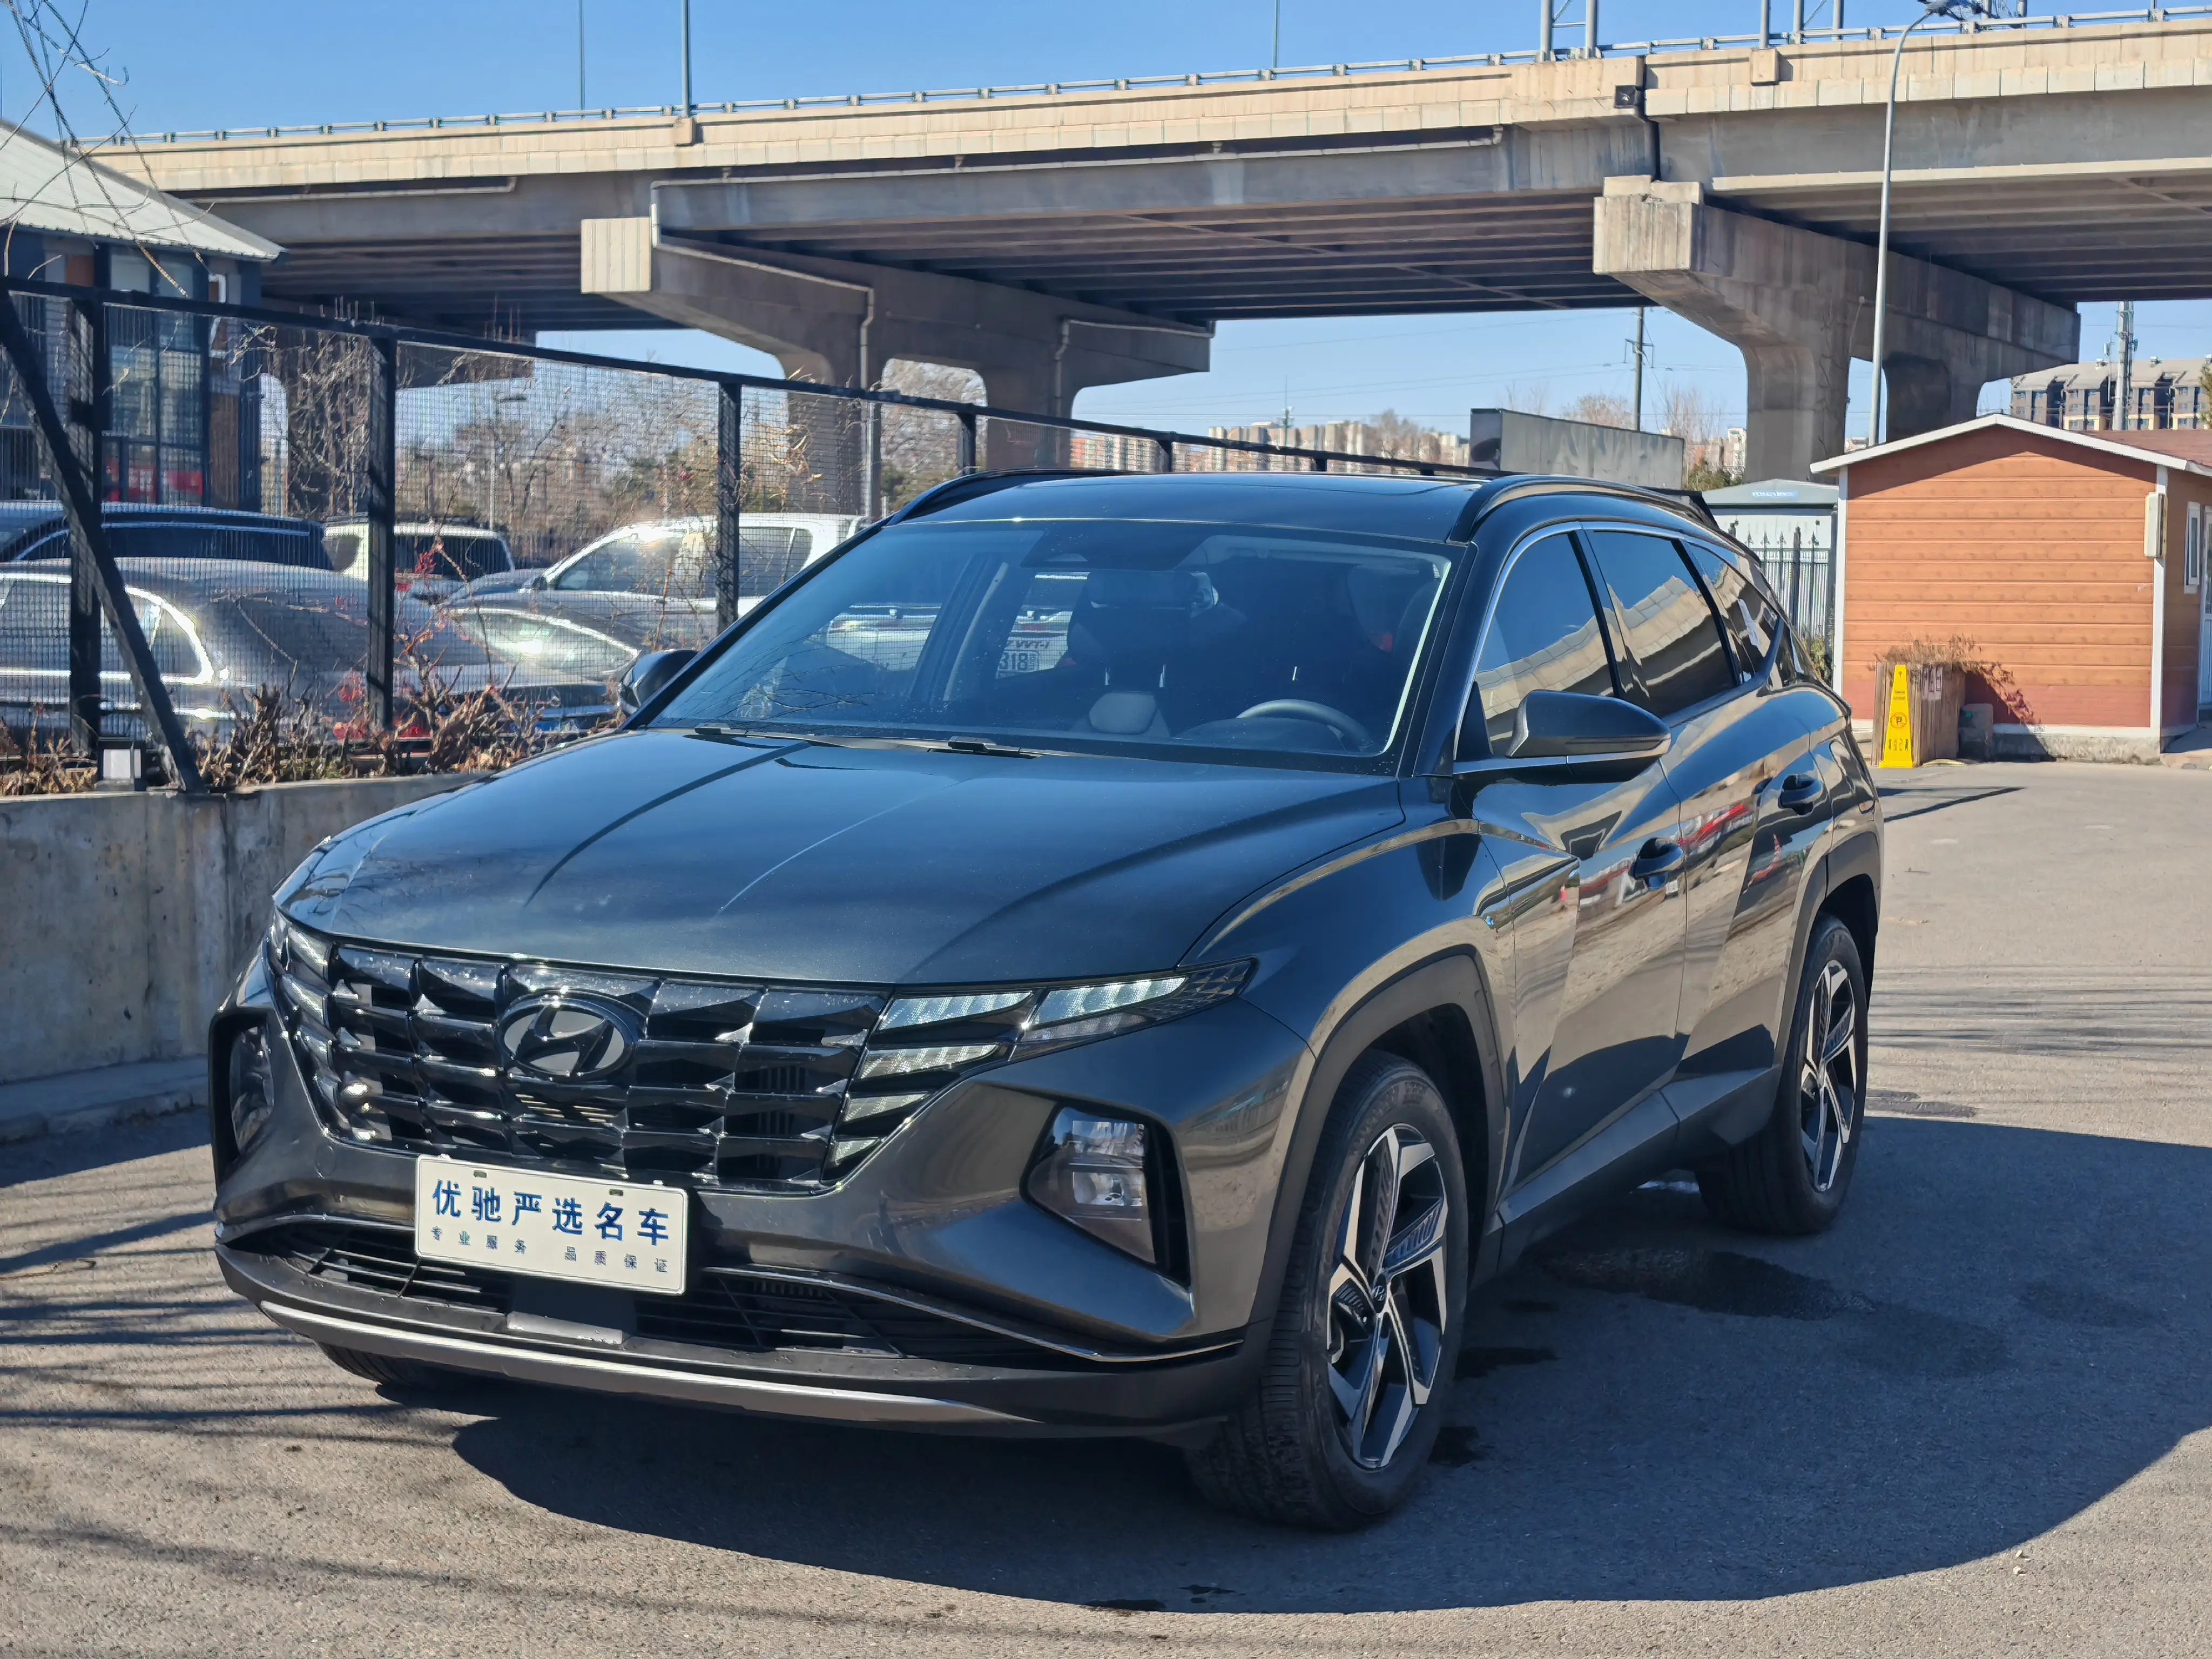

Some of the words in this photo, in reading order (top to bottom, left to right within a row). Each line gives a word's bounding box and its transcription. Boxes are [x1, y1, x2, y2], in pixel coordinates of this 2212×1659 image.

[433, 1179, 669, 1246] 优驰严选名车
